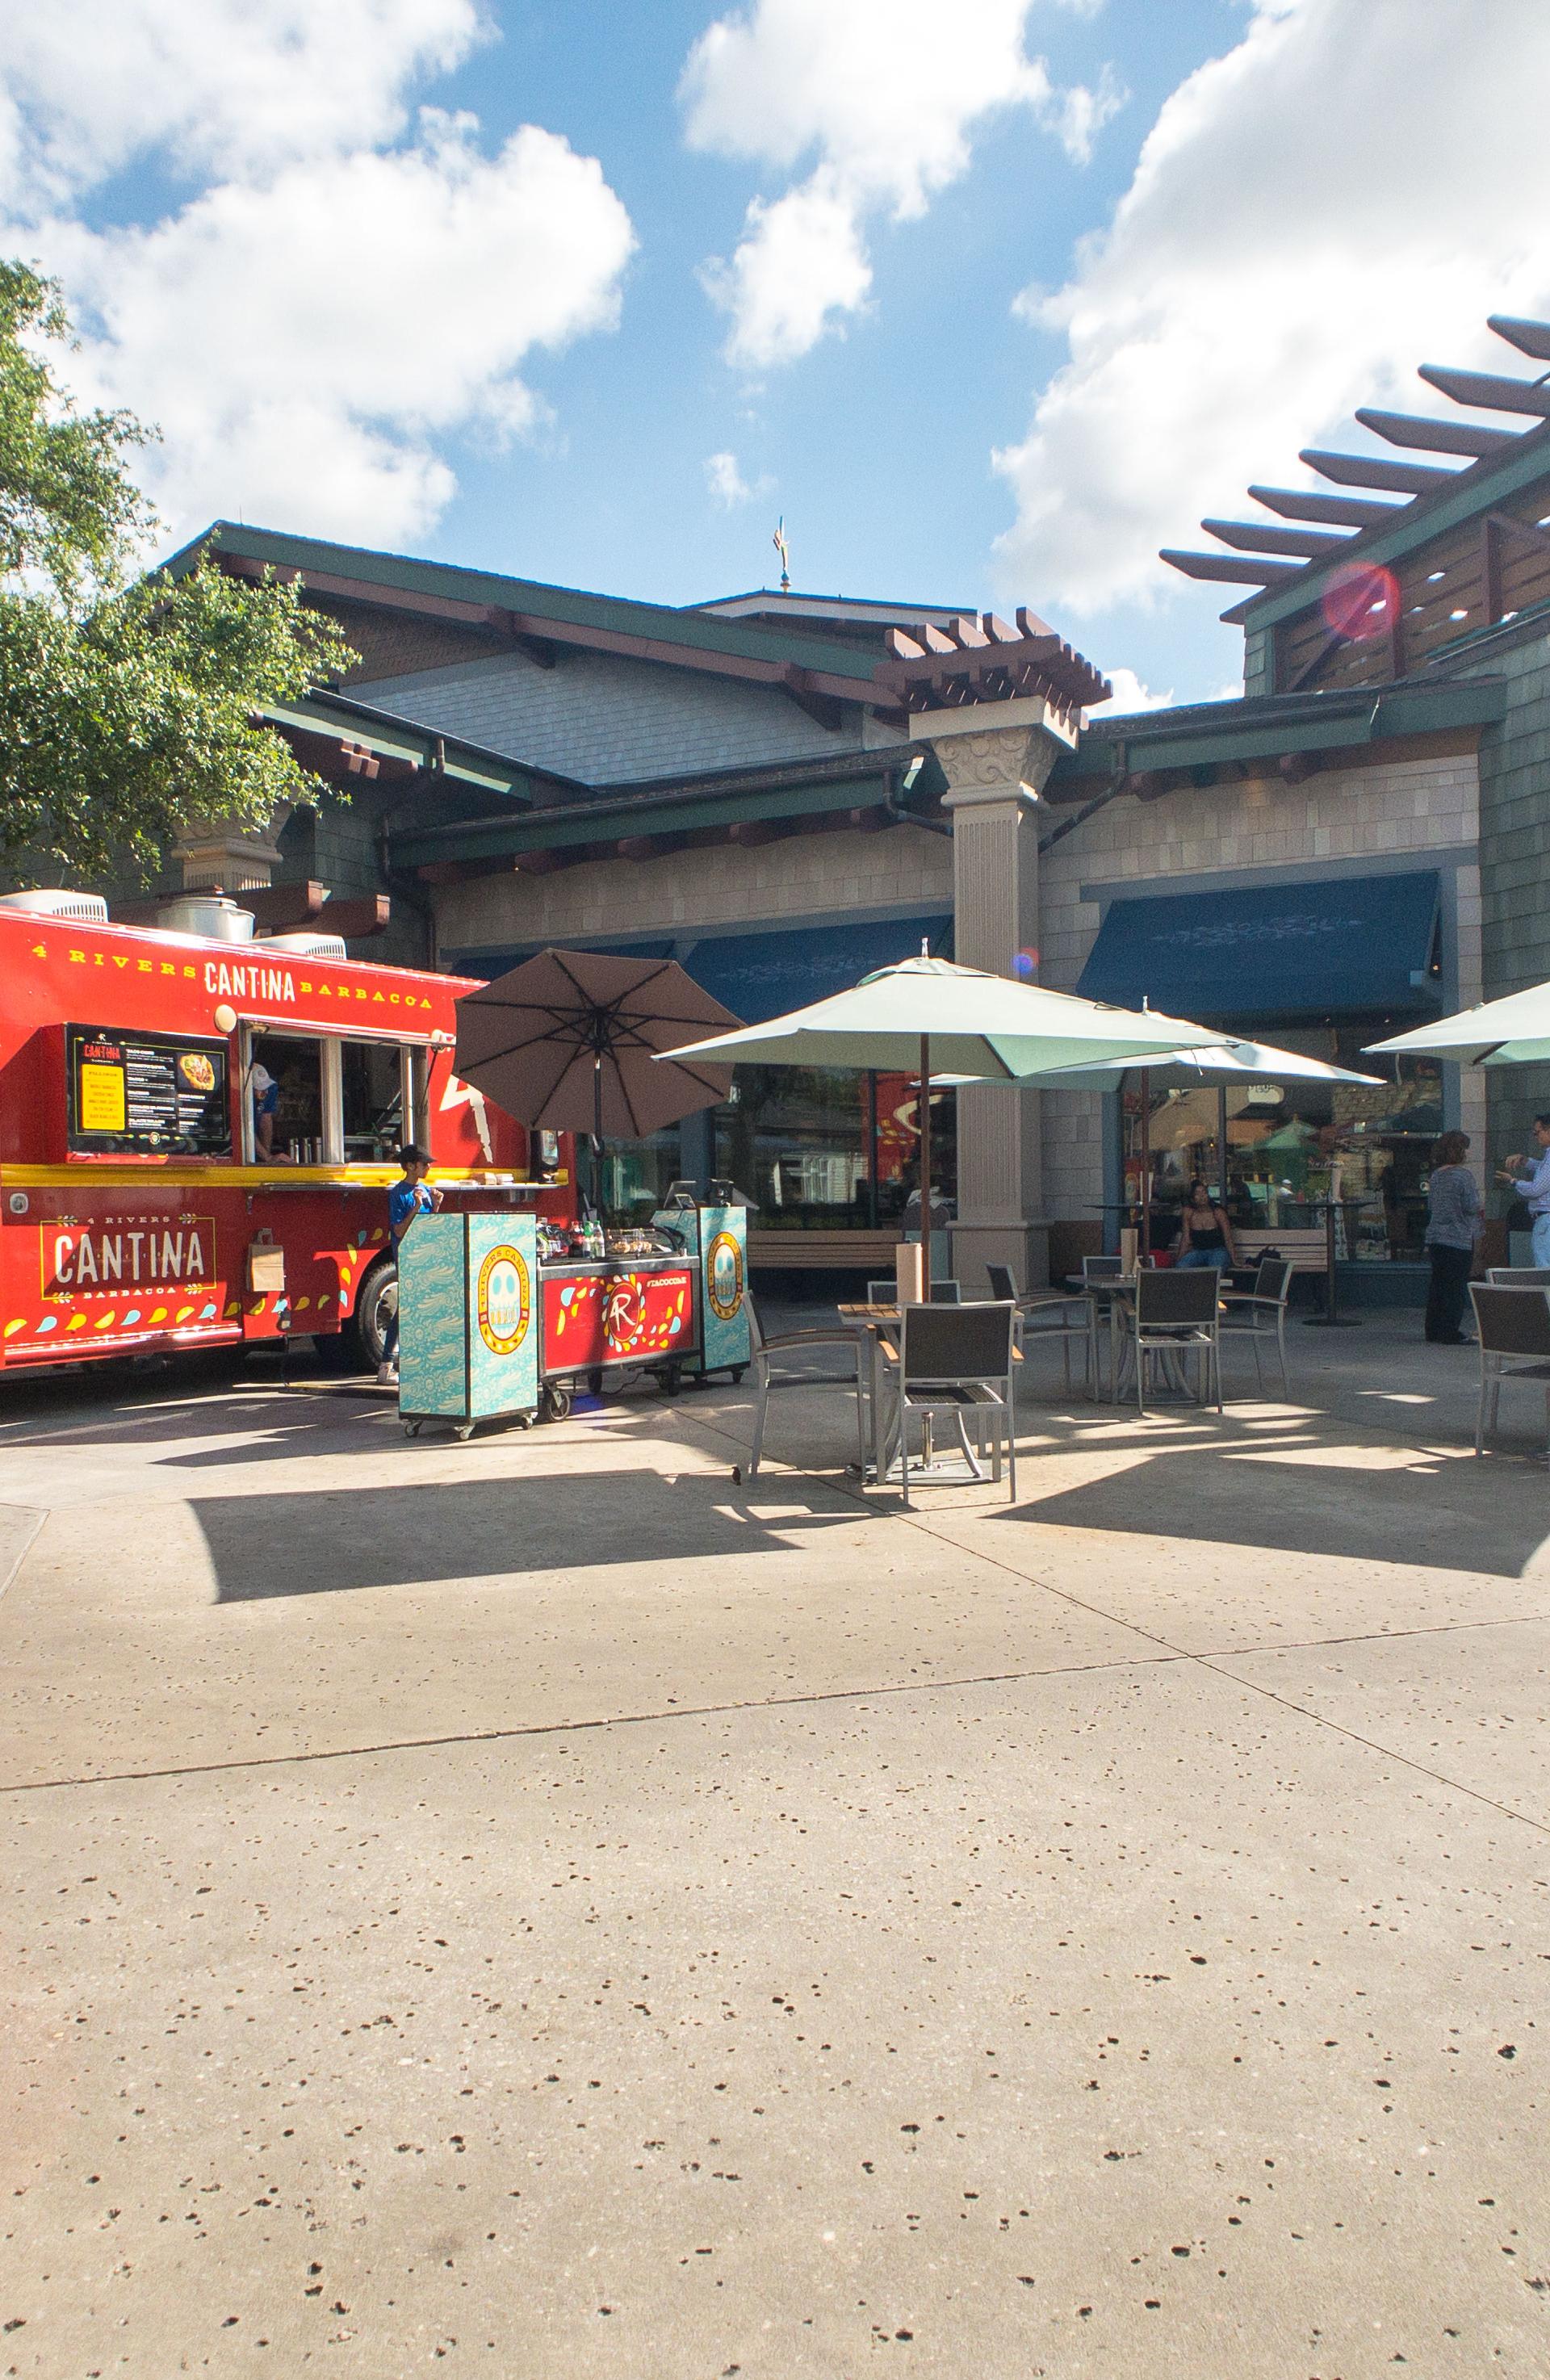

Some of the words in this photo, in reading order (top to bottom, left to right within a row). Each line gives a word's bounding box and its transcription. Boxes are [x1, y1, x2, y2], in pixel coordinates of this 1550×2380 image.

[32, 945, 47, 958] 4
[69, 949, 196, 978] RIVERS
[204, 962, 295, 1002] CANTINA
[300, 982, 432, 1009] BARBACOA
[84, 1044, 120, 1060] CANTINA
[105, 1216, 170, 1224] RIVERS
[55, 1230, 204, 1284] CANTINA
[83, 1287, 176, 1299] BARBACOA
[505, 1249, 527, 1304] CANTINA
